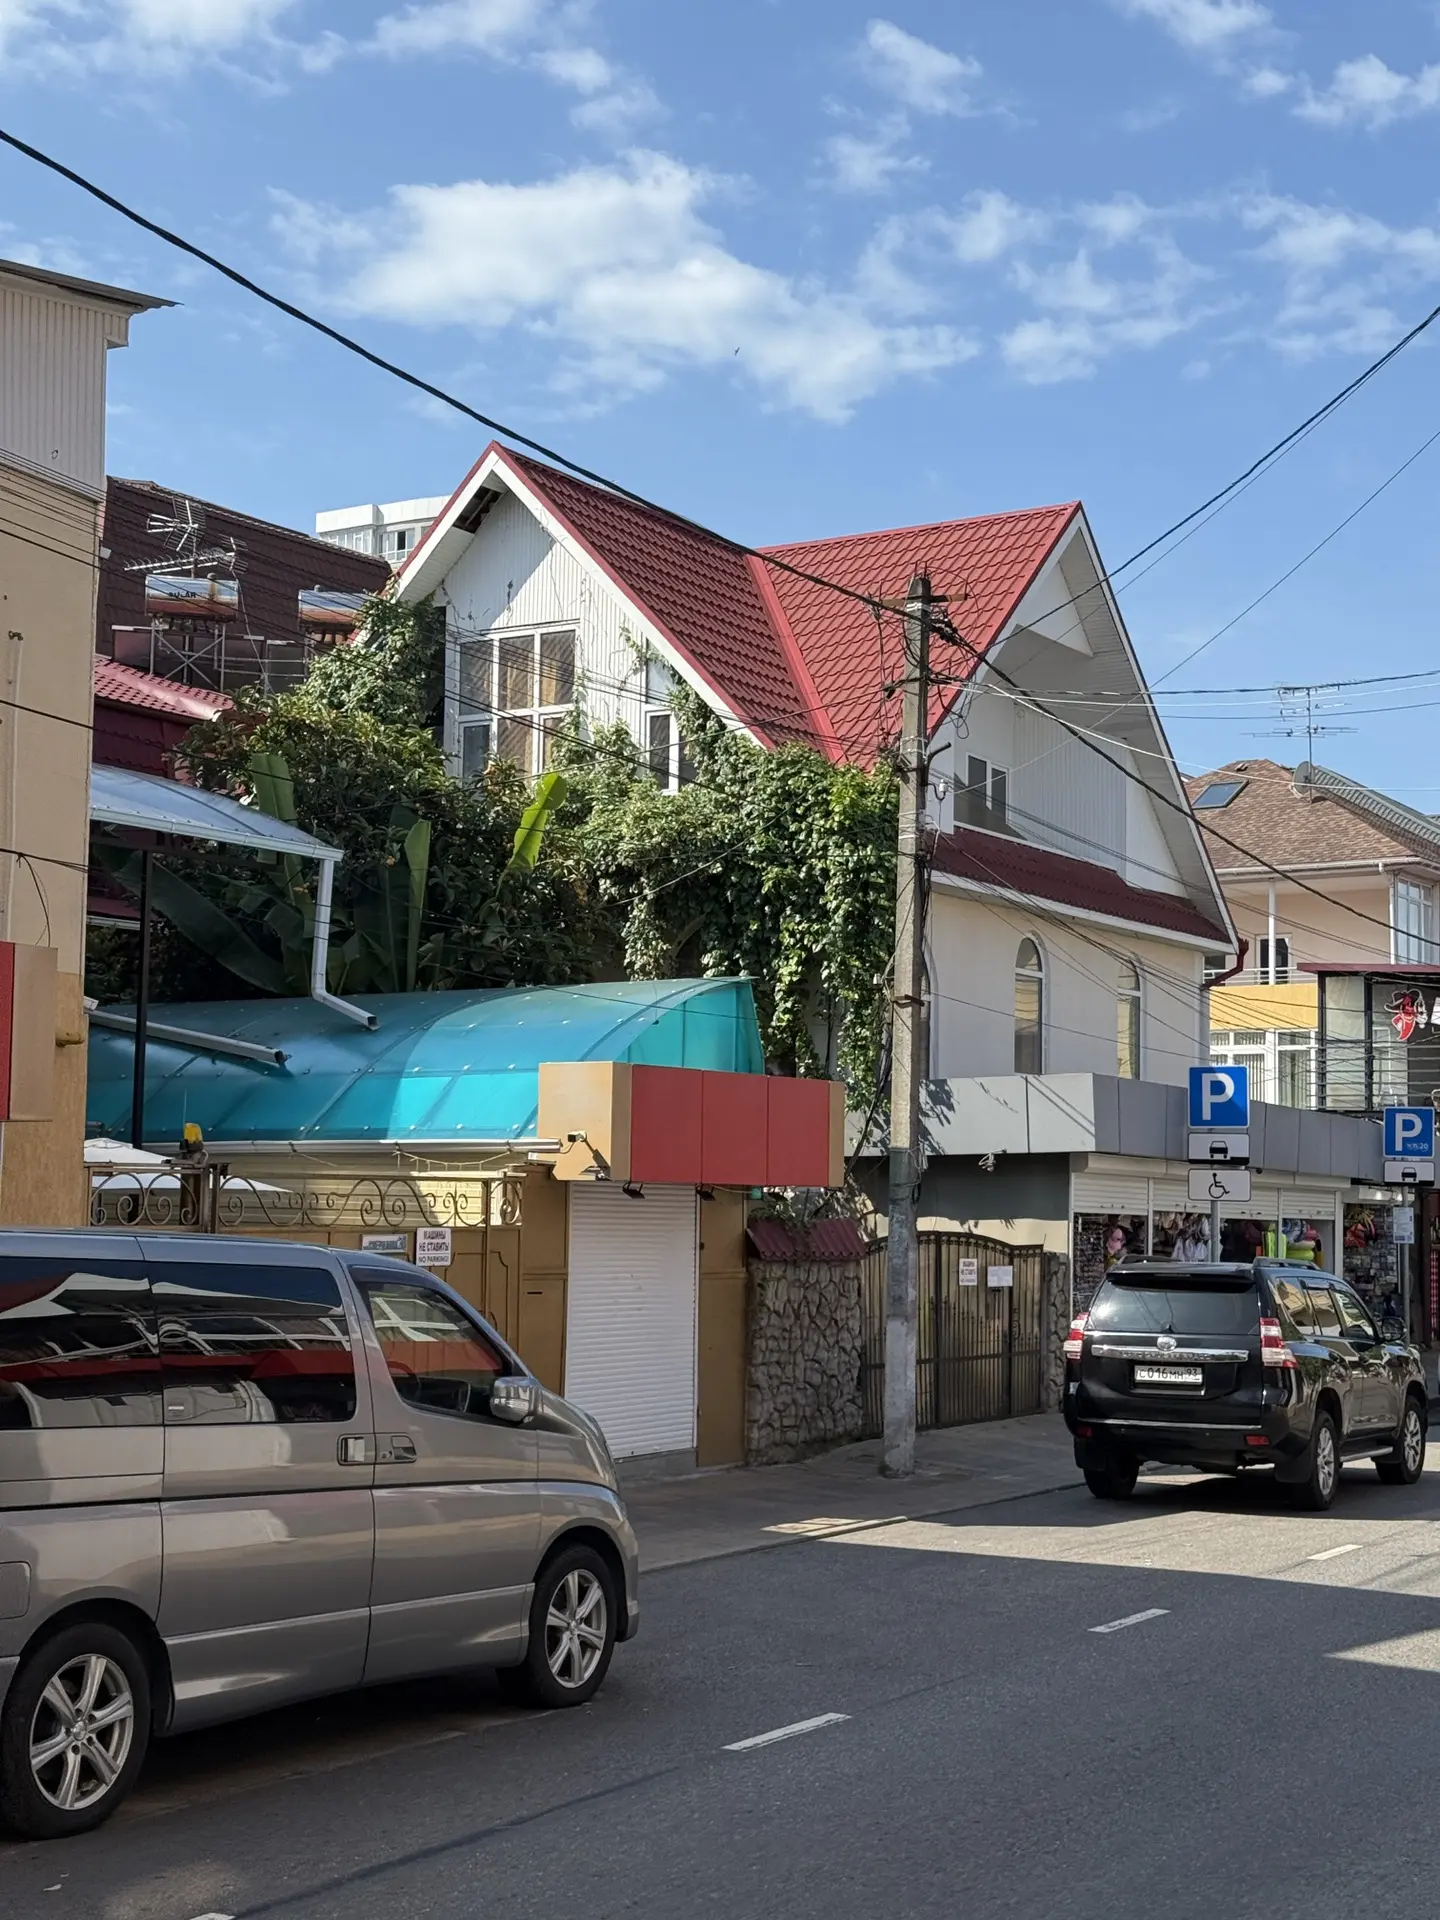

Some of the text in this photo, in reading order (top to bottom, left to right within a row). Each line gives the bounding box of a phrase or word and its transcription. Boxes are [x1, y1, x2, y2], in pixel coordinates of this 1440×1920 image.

[1202, 1073, 1234, 1120] P
[1395, 1113, 1422, 1151] P
[419, 1242, 426, 1251] НЕ
